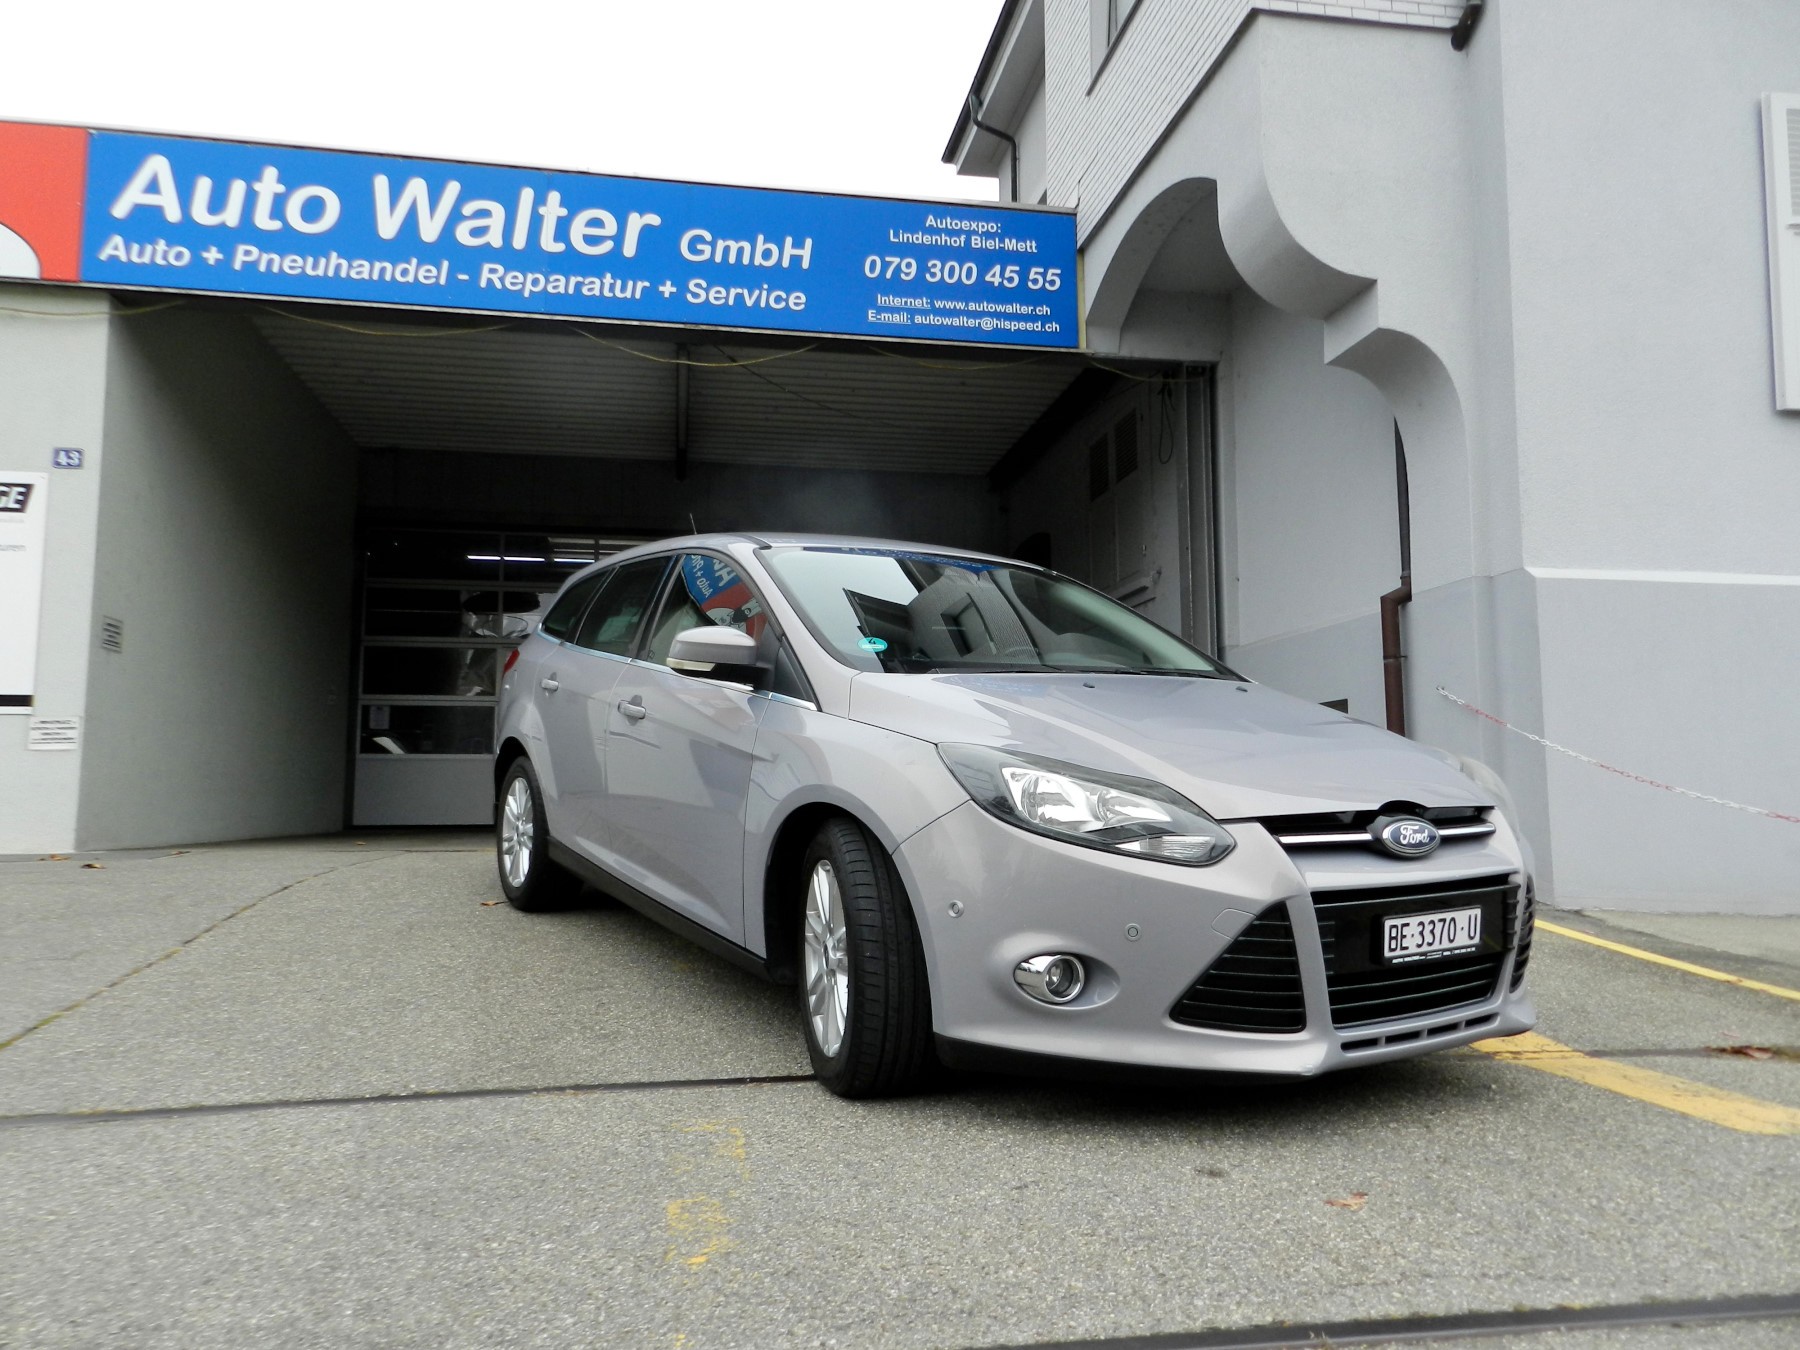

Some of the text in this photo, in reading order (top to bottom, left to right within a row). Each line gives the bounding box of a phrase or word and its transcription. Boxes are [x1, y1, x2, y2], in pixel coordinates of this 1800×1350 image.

[108, 153, 813, 270] Auto Walter GmbH
[925, 214, 1002, 235] Autoexpo:
[889, 229, 1038, 254] Lindenhof Biel-Mett
[98, 233, 192, 267] Auto
[201, 245, 224, 266] +
[232, 243, 450, 287] Pneuhandel
[478, 262, 651, 300] Reparatur
[659, 280, 677, 298] +
[686, 279, 807, 311] Service
[864, 255, 1062, 291] 079 300 45 55
[877, 294, 1051, 316] Internet: www.autowalter.ch
[868, 309, 1060, 333] E-mail: autowalter@hispeed.ch
[56, 450, 81, 466] 43
[1400, 825, 1430, 845] Ford
